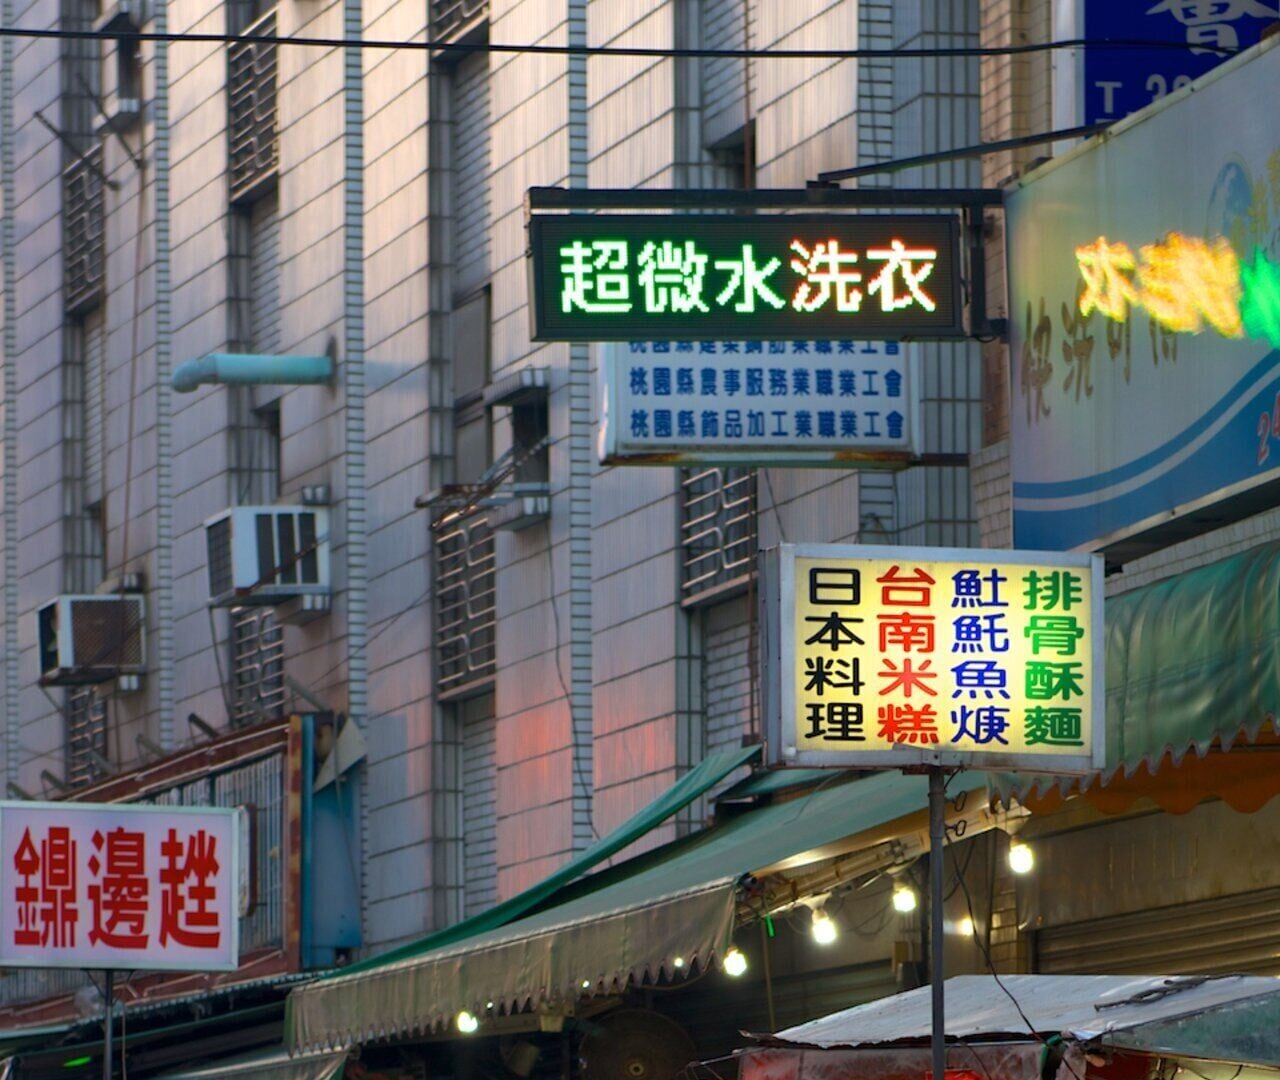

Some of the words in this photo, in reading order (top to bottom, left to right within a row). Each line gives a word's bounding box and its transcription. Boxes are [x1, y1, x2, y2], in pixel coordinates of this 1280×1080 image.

[560, 238, 938, 313] 超微水洗衣
[804, 567, 866, 742] 日本料理
[876, 565, 939, 744] 台南米糕
[1022, 570, 1085, 746] 排骨酥麵
